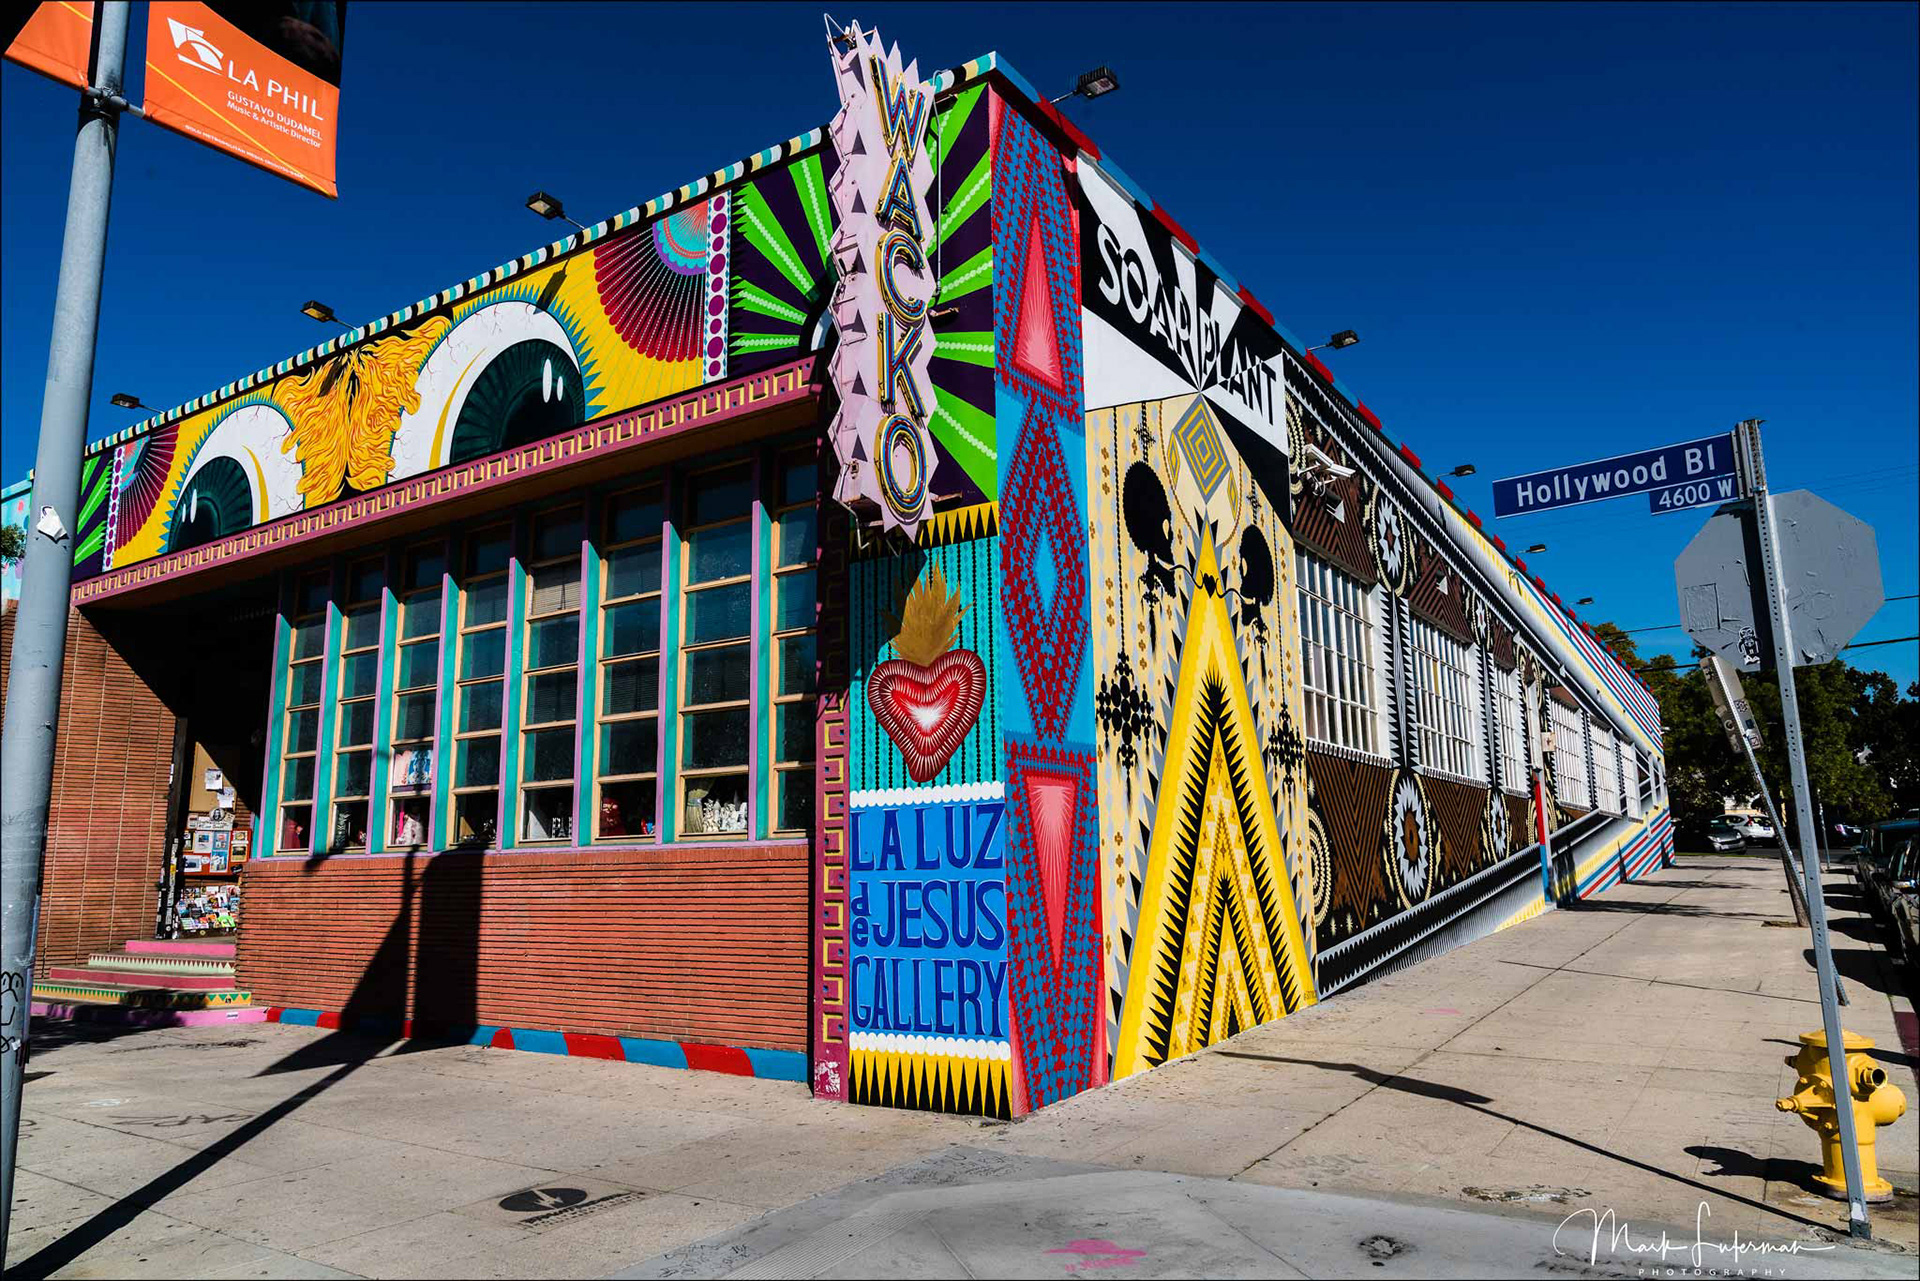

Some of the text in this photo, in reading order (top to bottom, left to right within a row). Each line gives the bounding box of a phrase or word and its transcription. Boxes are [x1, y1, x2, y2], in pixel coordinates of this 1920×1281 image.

[227, 90, 323, 141] GUSTAVO DUDAMEL
[228, 60, 324, 121] LA PHIL
[227, 100, 321, 148] Music & Artistic Director
[871, 54, 929, 525] WACKO
[1097, 222, 1277, 426] SOAP PLANT
[1516, 455, 1667, 507] Hollywood
[1659, 478, 1733, 508] 4600 W
[850, 802, 1006, 871] LA LUZ
[871, 879, 1006, 951] JESUS
[850, 954, 1009, 1038] GALLERY
